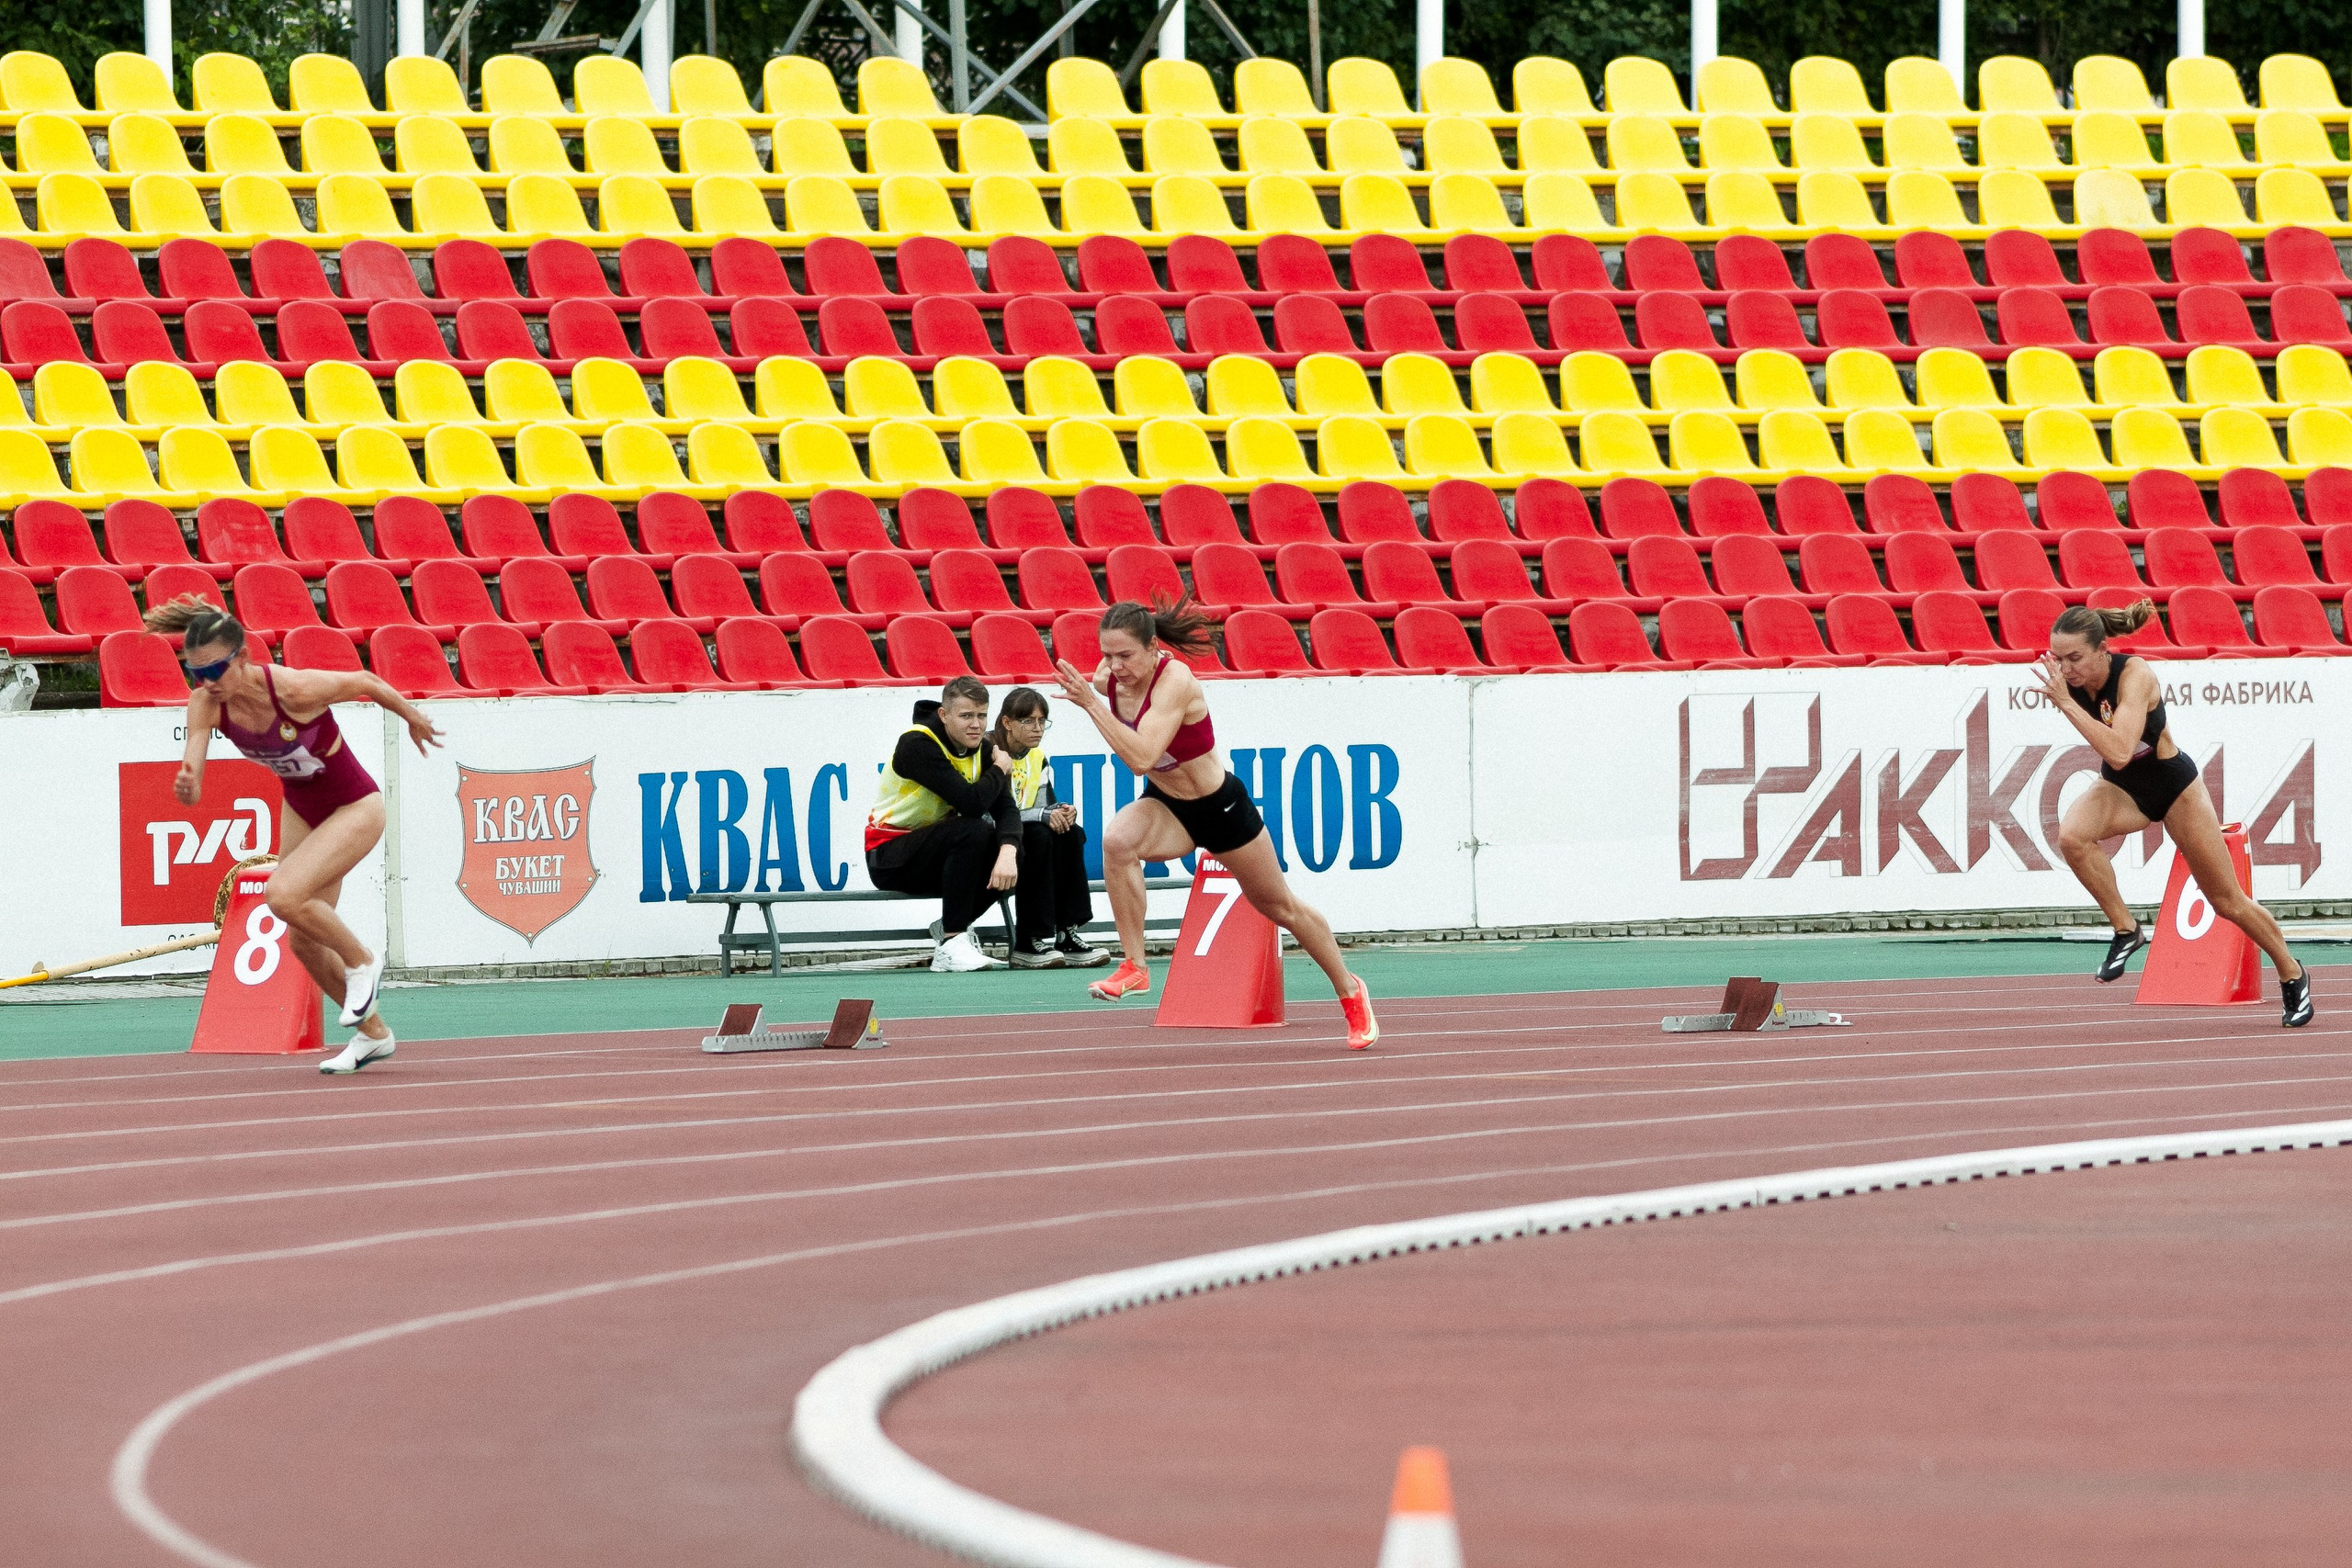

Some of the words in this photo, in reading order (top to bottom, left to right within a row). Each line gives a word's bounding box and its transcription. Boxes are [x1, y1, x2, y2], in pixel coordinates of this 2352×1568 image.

[2202, 681, 2314, 705] ФАБРИКА
[472, 793, 581, 843] КВАС
[639, 762, 849, 903] КВАС
[495, 854, 565, 880] БУКЕТ
[498, 879, 561, 896] ЧУВАШИИ
[1193, 877, 1243, 957] 7
[2176, 873, 2217, 941] 6
[233, 903, 288, 987] 8
